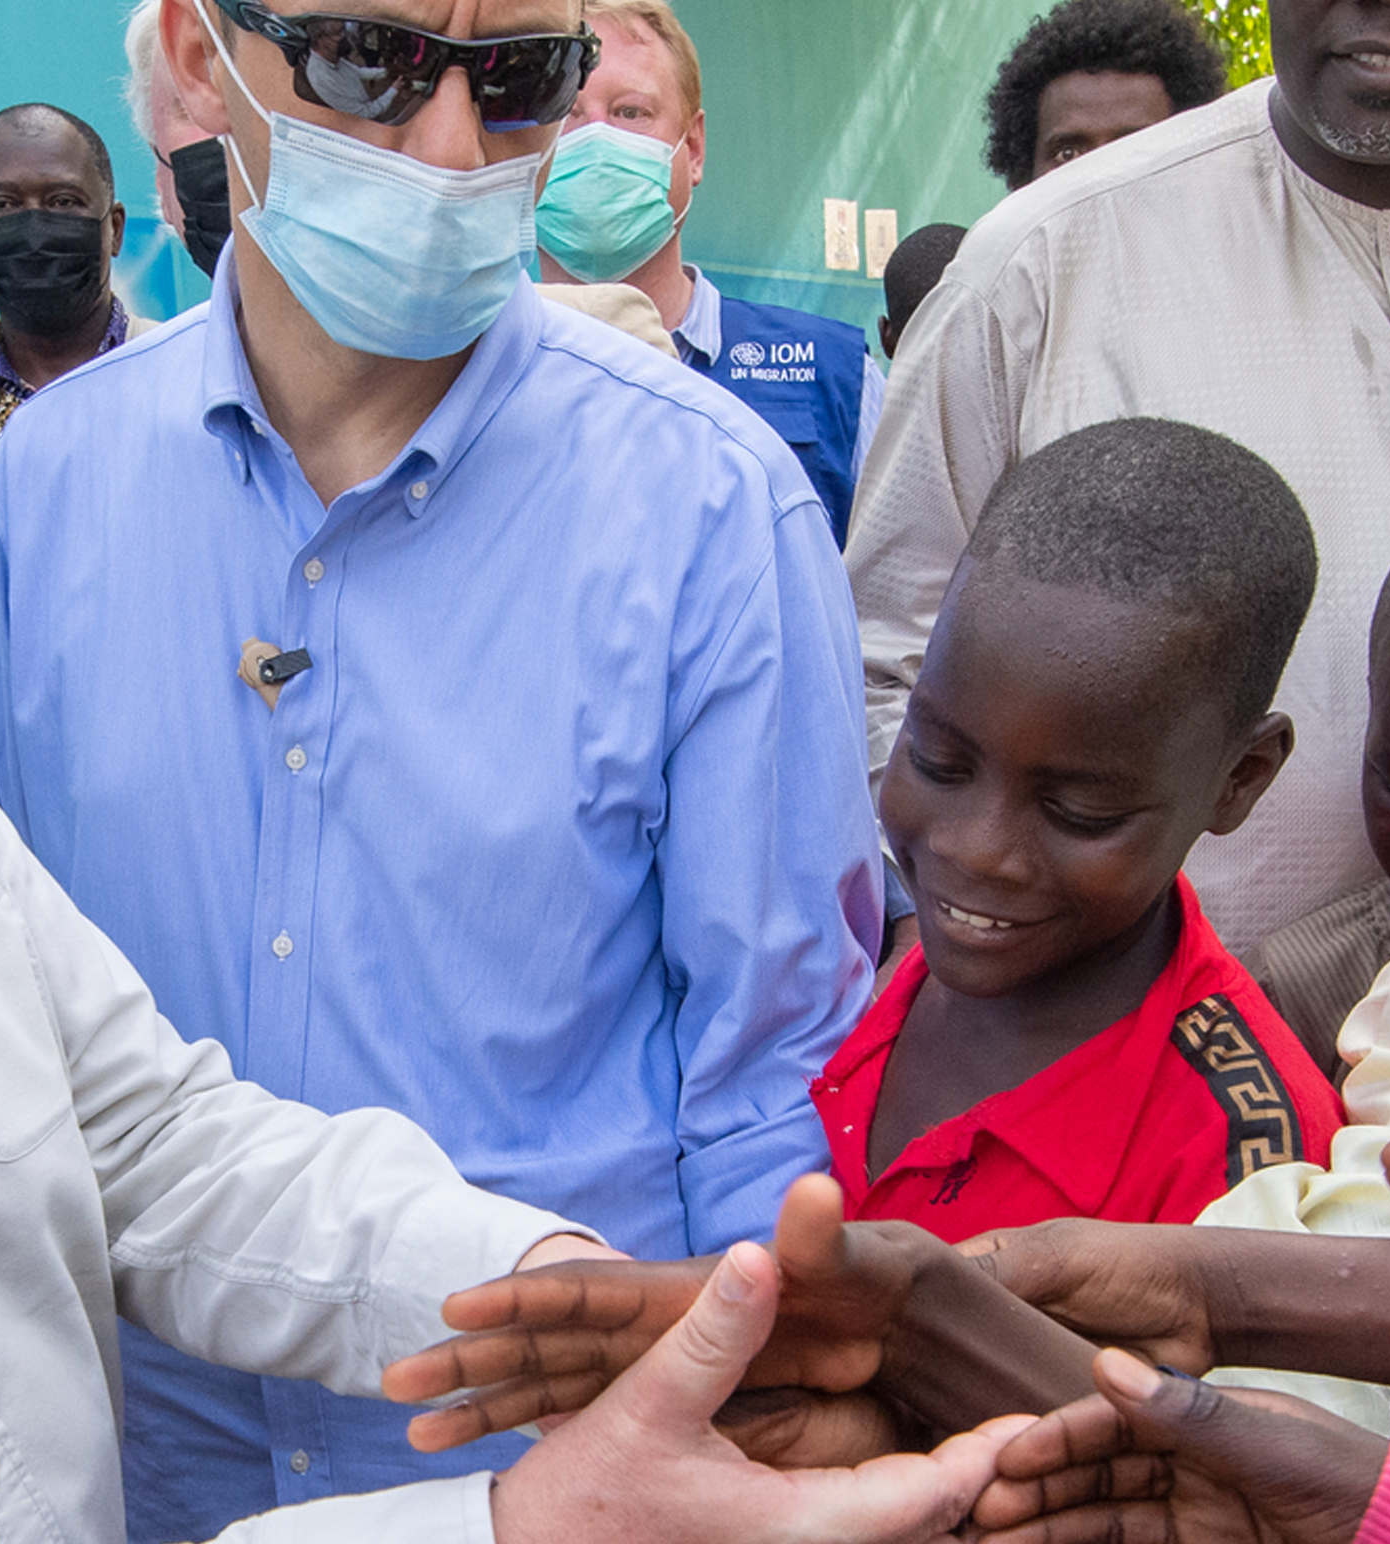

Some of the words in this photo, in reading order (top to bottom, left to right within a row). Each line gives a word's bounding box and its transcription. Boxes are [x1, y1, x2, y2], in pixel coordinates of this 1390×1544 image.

[771, 341, 814, 364] IOM
[731, 367, 748, 380] UN
[751, 367, 815, 382] MIGRATION
